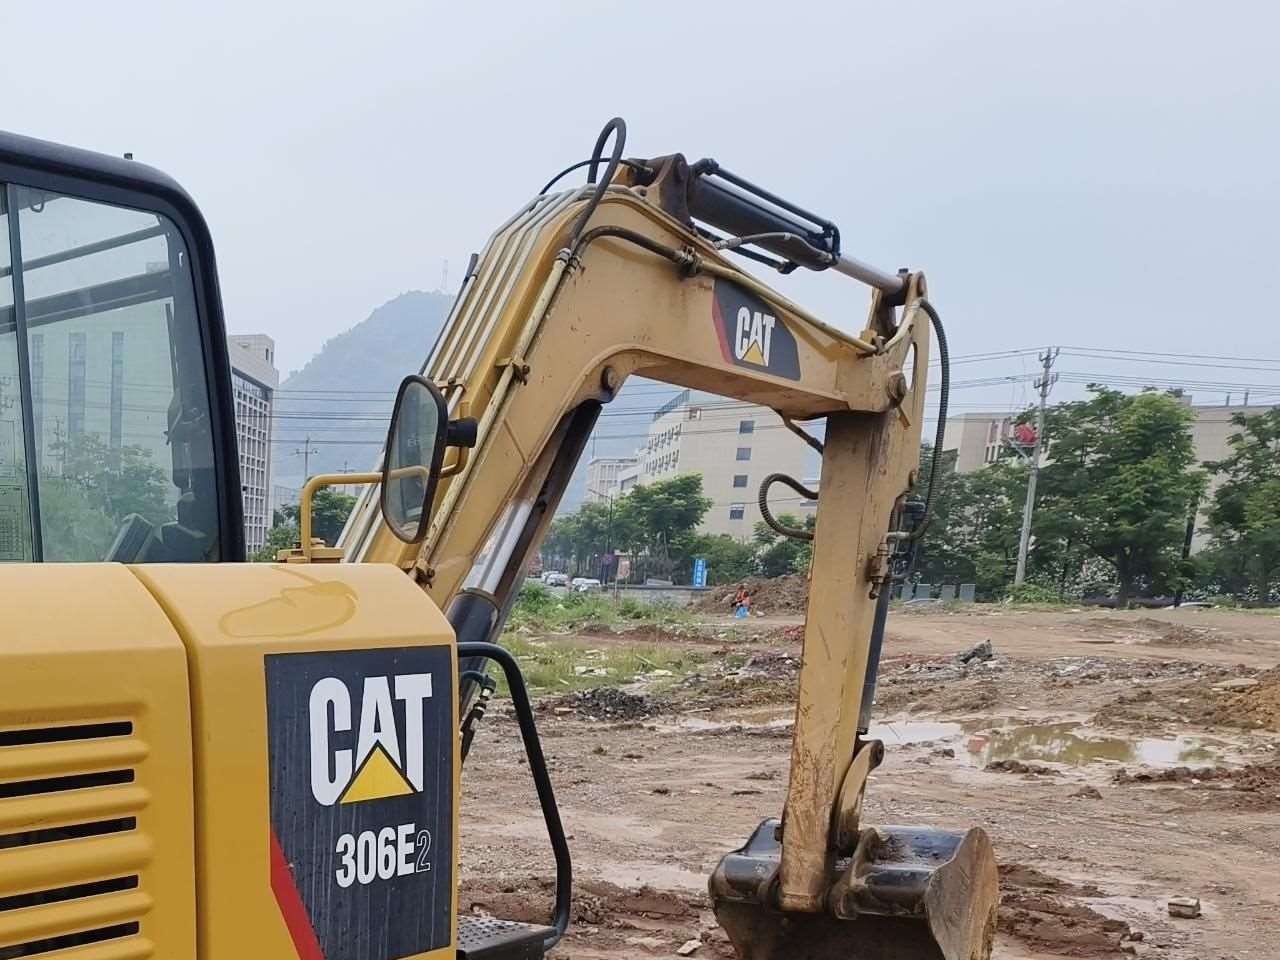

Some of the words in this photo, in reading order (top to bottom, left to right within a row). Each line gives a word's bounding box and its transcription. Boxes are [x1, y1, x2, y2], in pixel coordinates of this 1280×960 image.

[734, 306, 776, 367] CAT
[308, 672, 434, 807] CAT
[334, 822, 432, 889] 306E2
